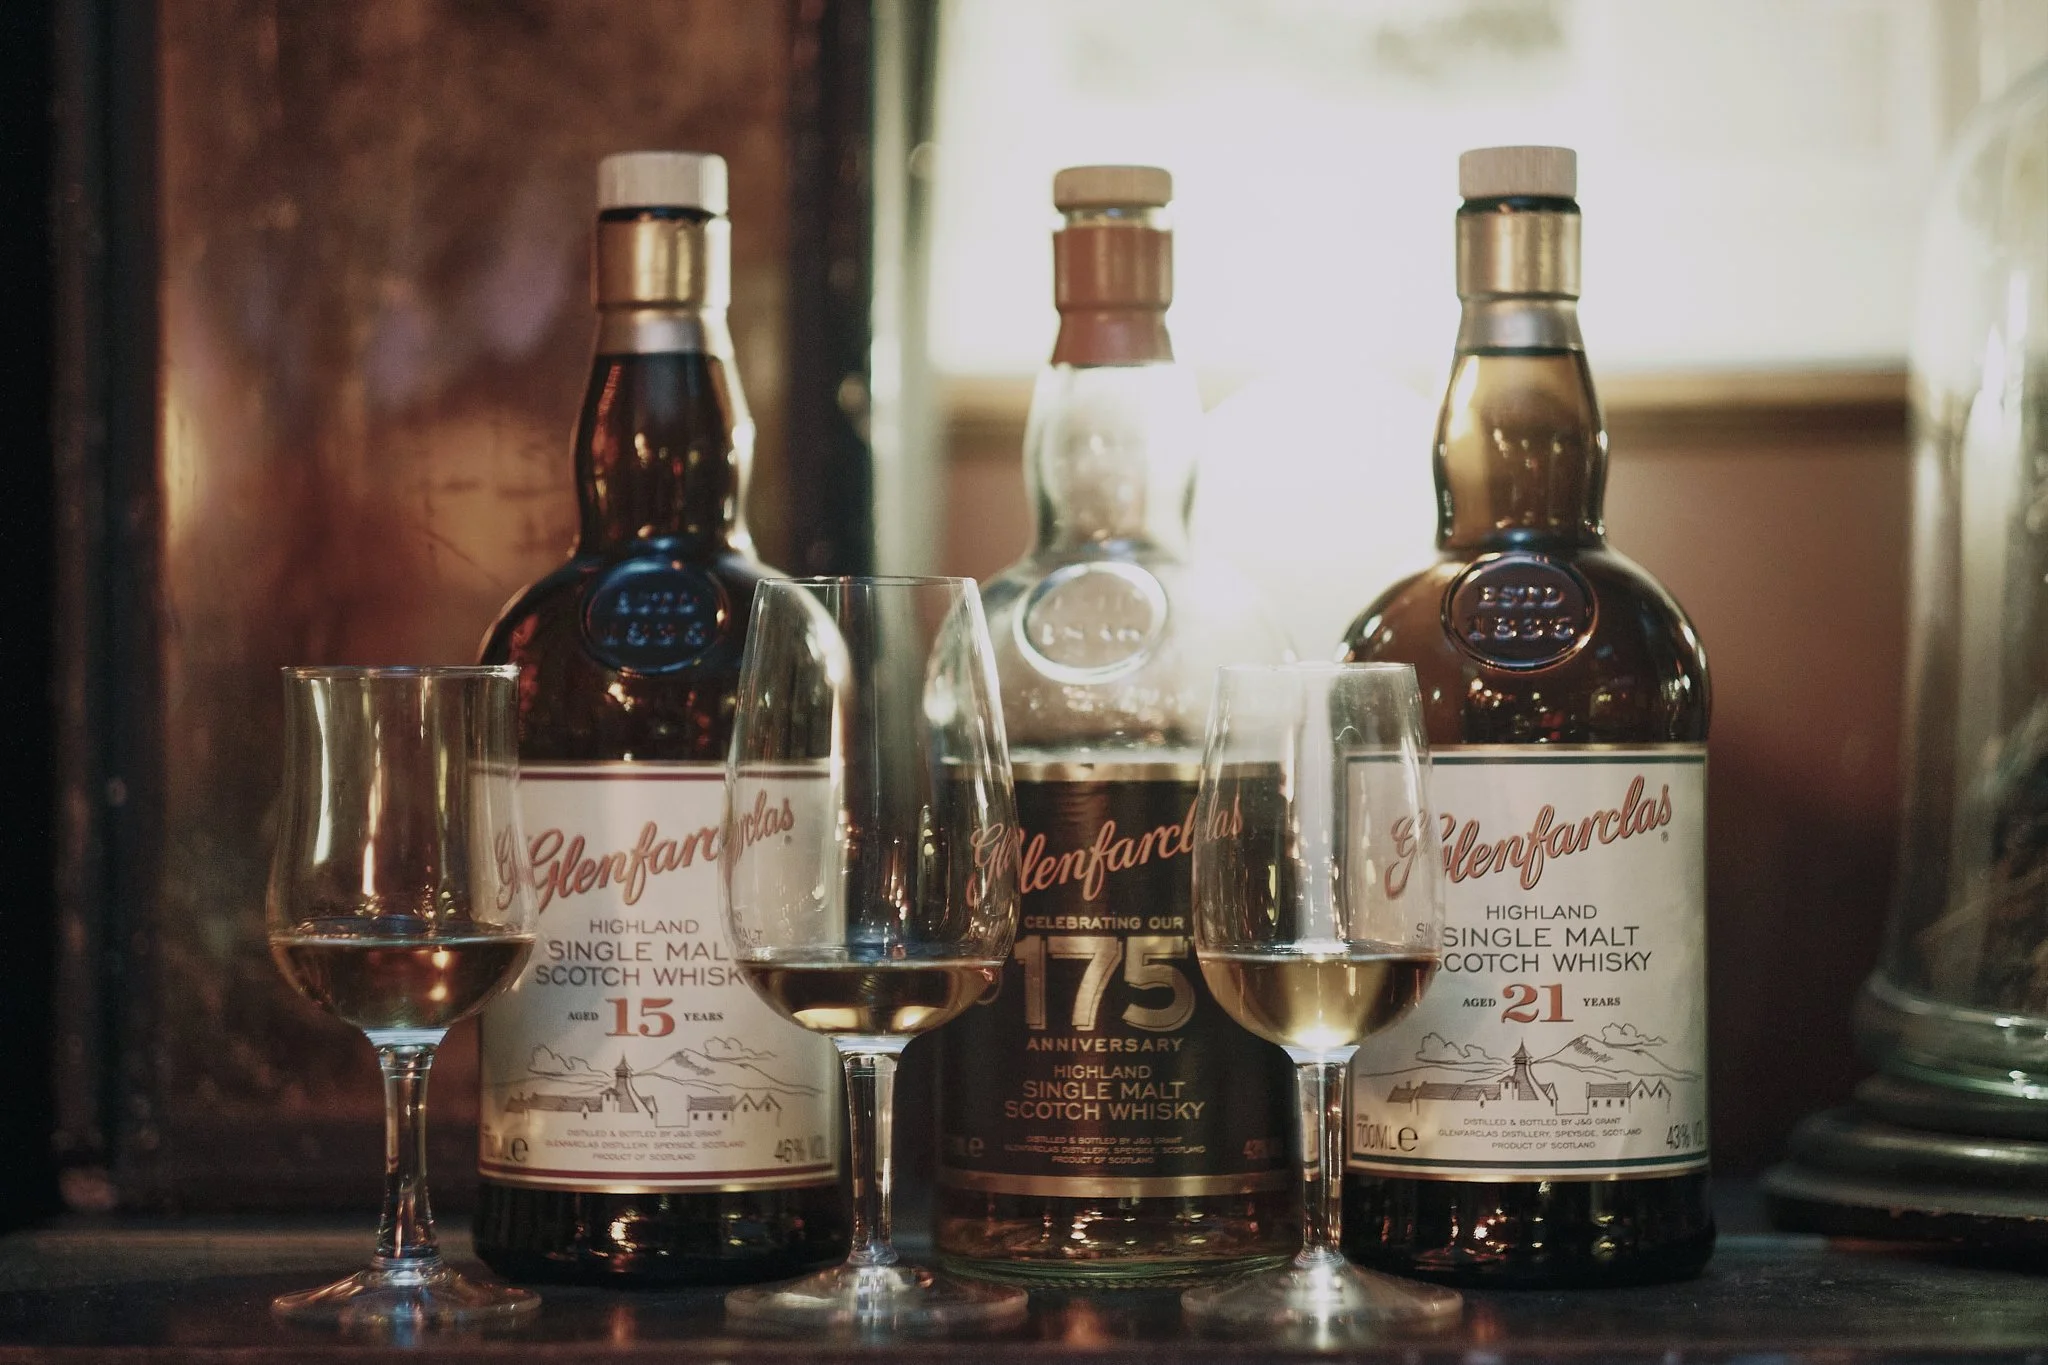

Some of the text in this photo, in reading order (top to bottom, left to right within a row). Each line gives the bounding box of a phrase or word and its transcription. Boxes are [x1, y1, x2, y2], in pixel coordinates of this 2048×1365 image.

[1384, 774, 1673, 900] Glenfarclas
[498, 788, 796, 914] Glenfarclas
[965, 790, 1243, 908] Glenfarclas
[1486, 904, 1598, 920] HIGHLAND
[589, 919, 700, 935] HIGHLAND
[1024, 916, 1185, 930] CELEBRATING OUR
[1442, 925, 1552, 948] SINGLE
[1565, 926, 1640, 947] MALT
[549, 941, 730, 962] SINGLE MAL
[1552, 951, 1652, 973] WHISKY
[535, 966, 745, 987] SCOTCH WHISK
[1462, 983, 1621, 1024] AGED 21 YEARS
[567, 997, 724, 1037] AGED 15 YEARS
[1026, 1037, 1185, 1053] ANNIVERSARY
[1053, 1064, 1152, 1080] HIGHLAND
[1022, 1081, 1186, 1100] SINGLE MALT
[1003, 1101, 1206, 1121] SCOTCH WHISKY
[1463, 1118, 1507, 1126] DISTILLED
[1510, 1118, 1517, 1126] &
[1519, 1118, 1558, 1126] BOTTLED
[1561, 1118, 1572, 1126] BY
[1491, 1142, 1533, 1150] PRODUCT
[1550, 1141, 1596, 1149] SCOTLAND
